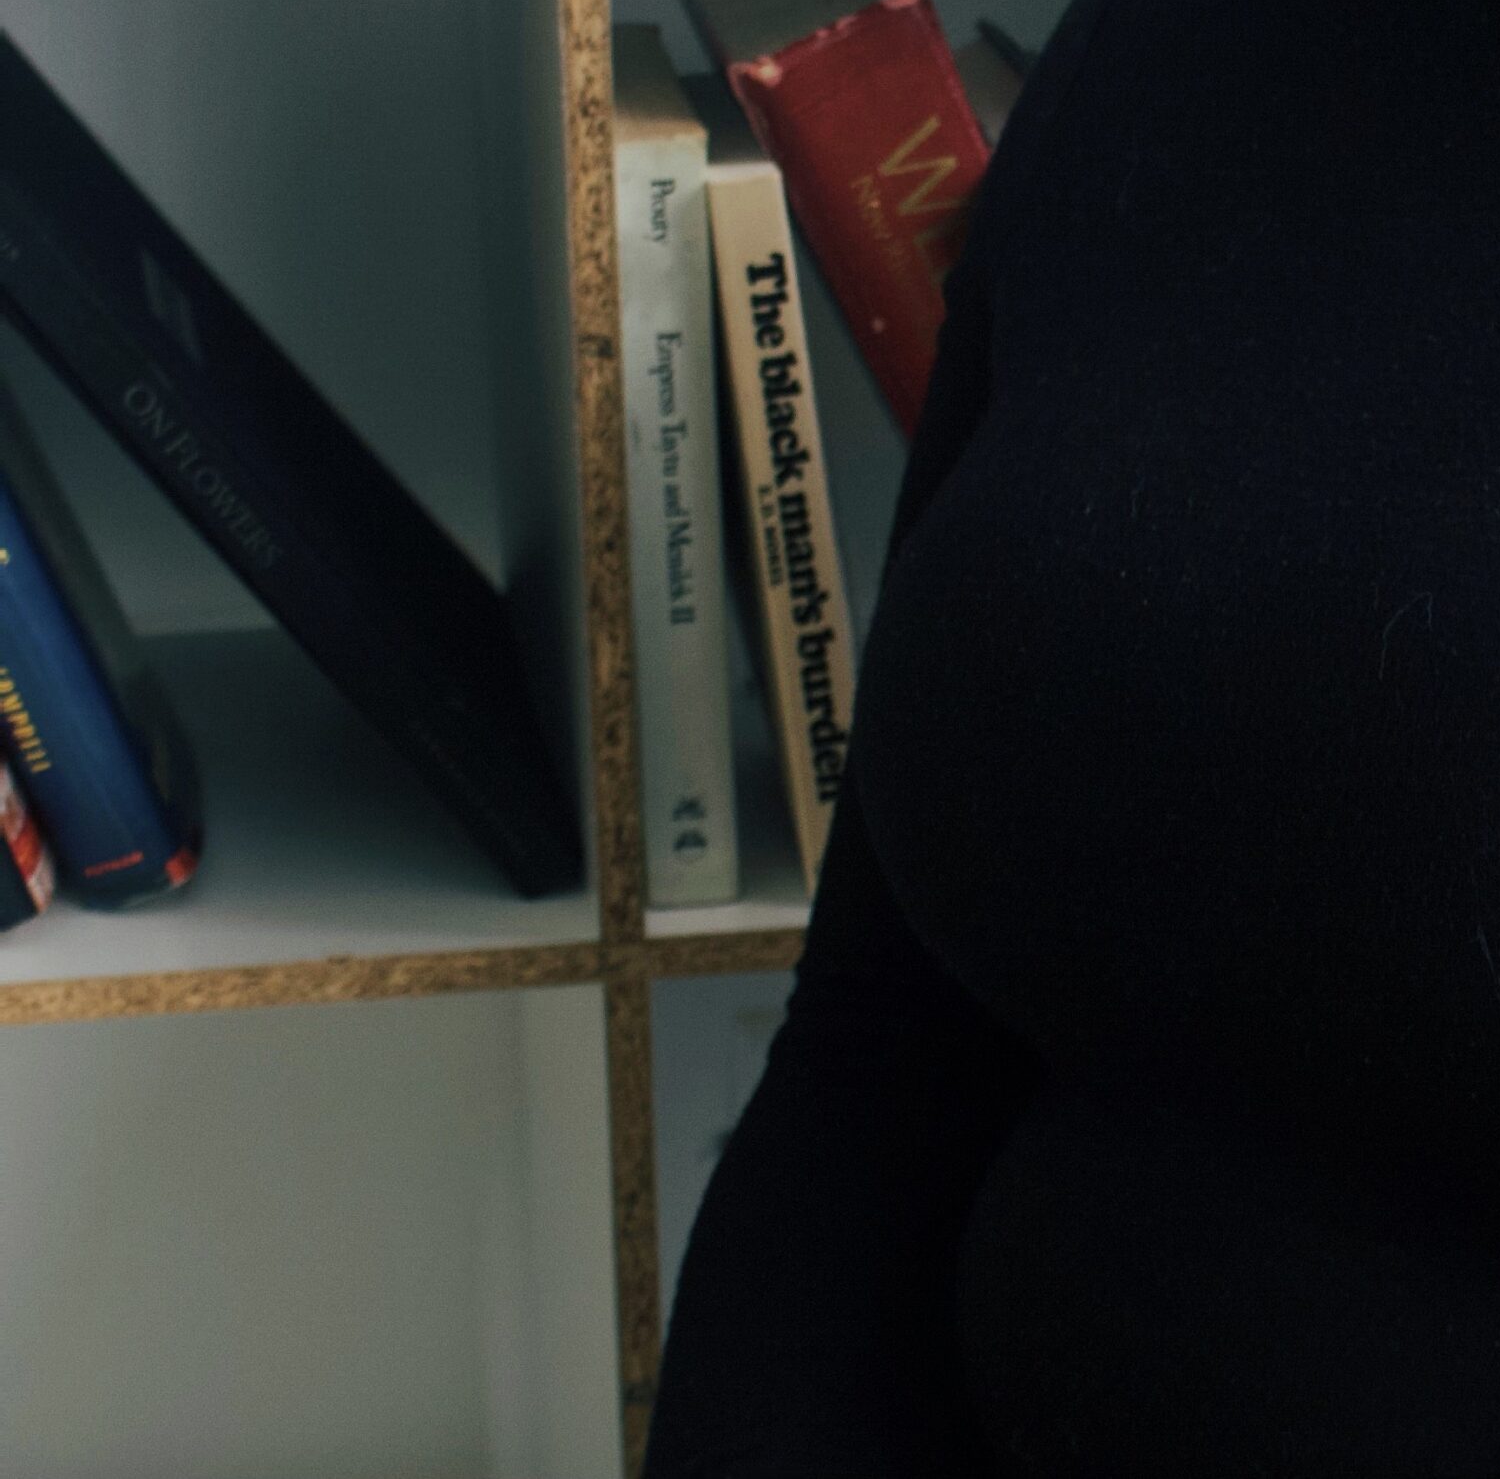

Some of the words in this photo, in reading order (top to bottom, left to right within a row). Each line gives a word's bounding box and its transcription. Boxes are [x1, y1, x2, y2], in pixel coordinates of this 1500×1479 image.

[746, 251, 789, 348] The
[124, 385, 175, 439] ON
[165, 428, 280, 569] FLOWERS
[760, 350, 811, 488] black
[664, 483, 690, 517] and
[777, 492, 831, 625] man's
[798, 628, 848, 804] burden
